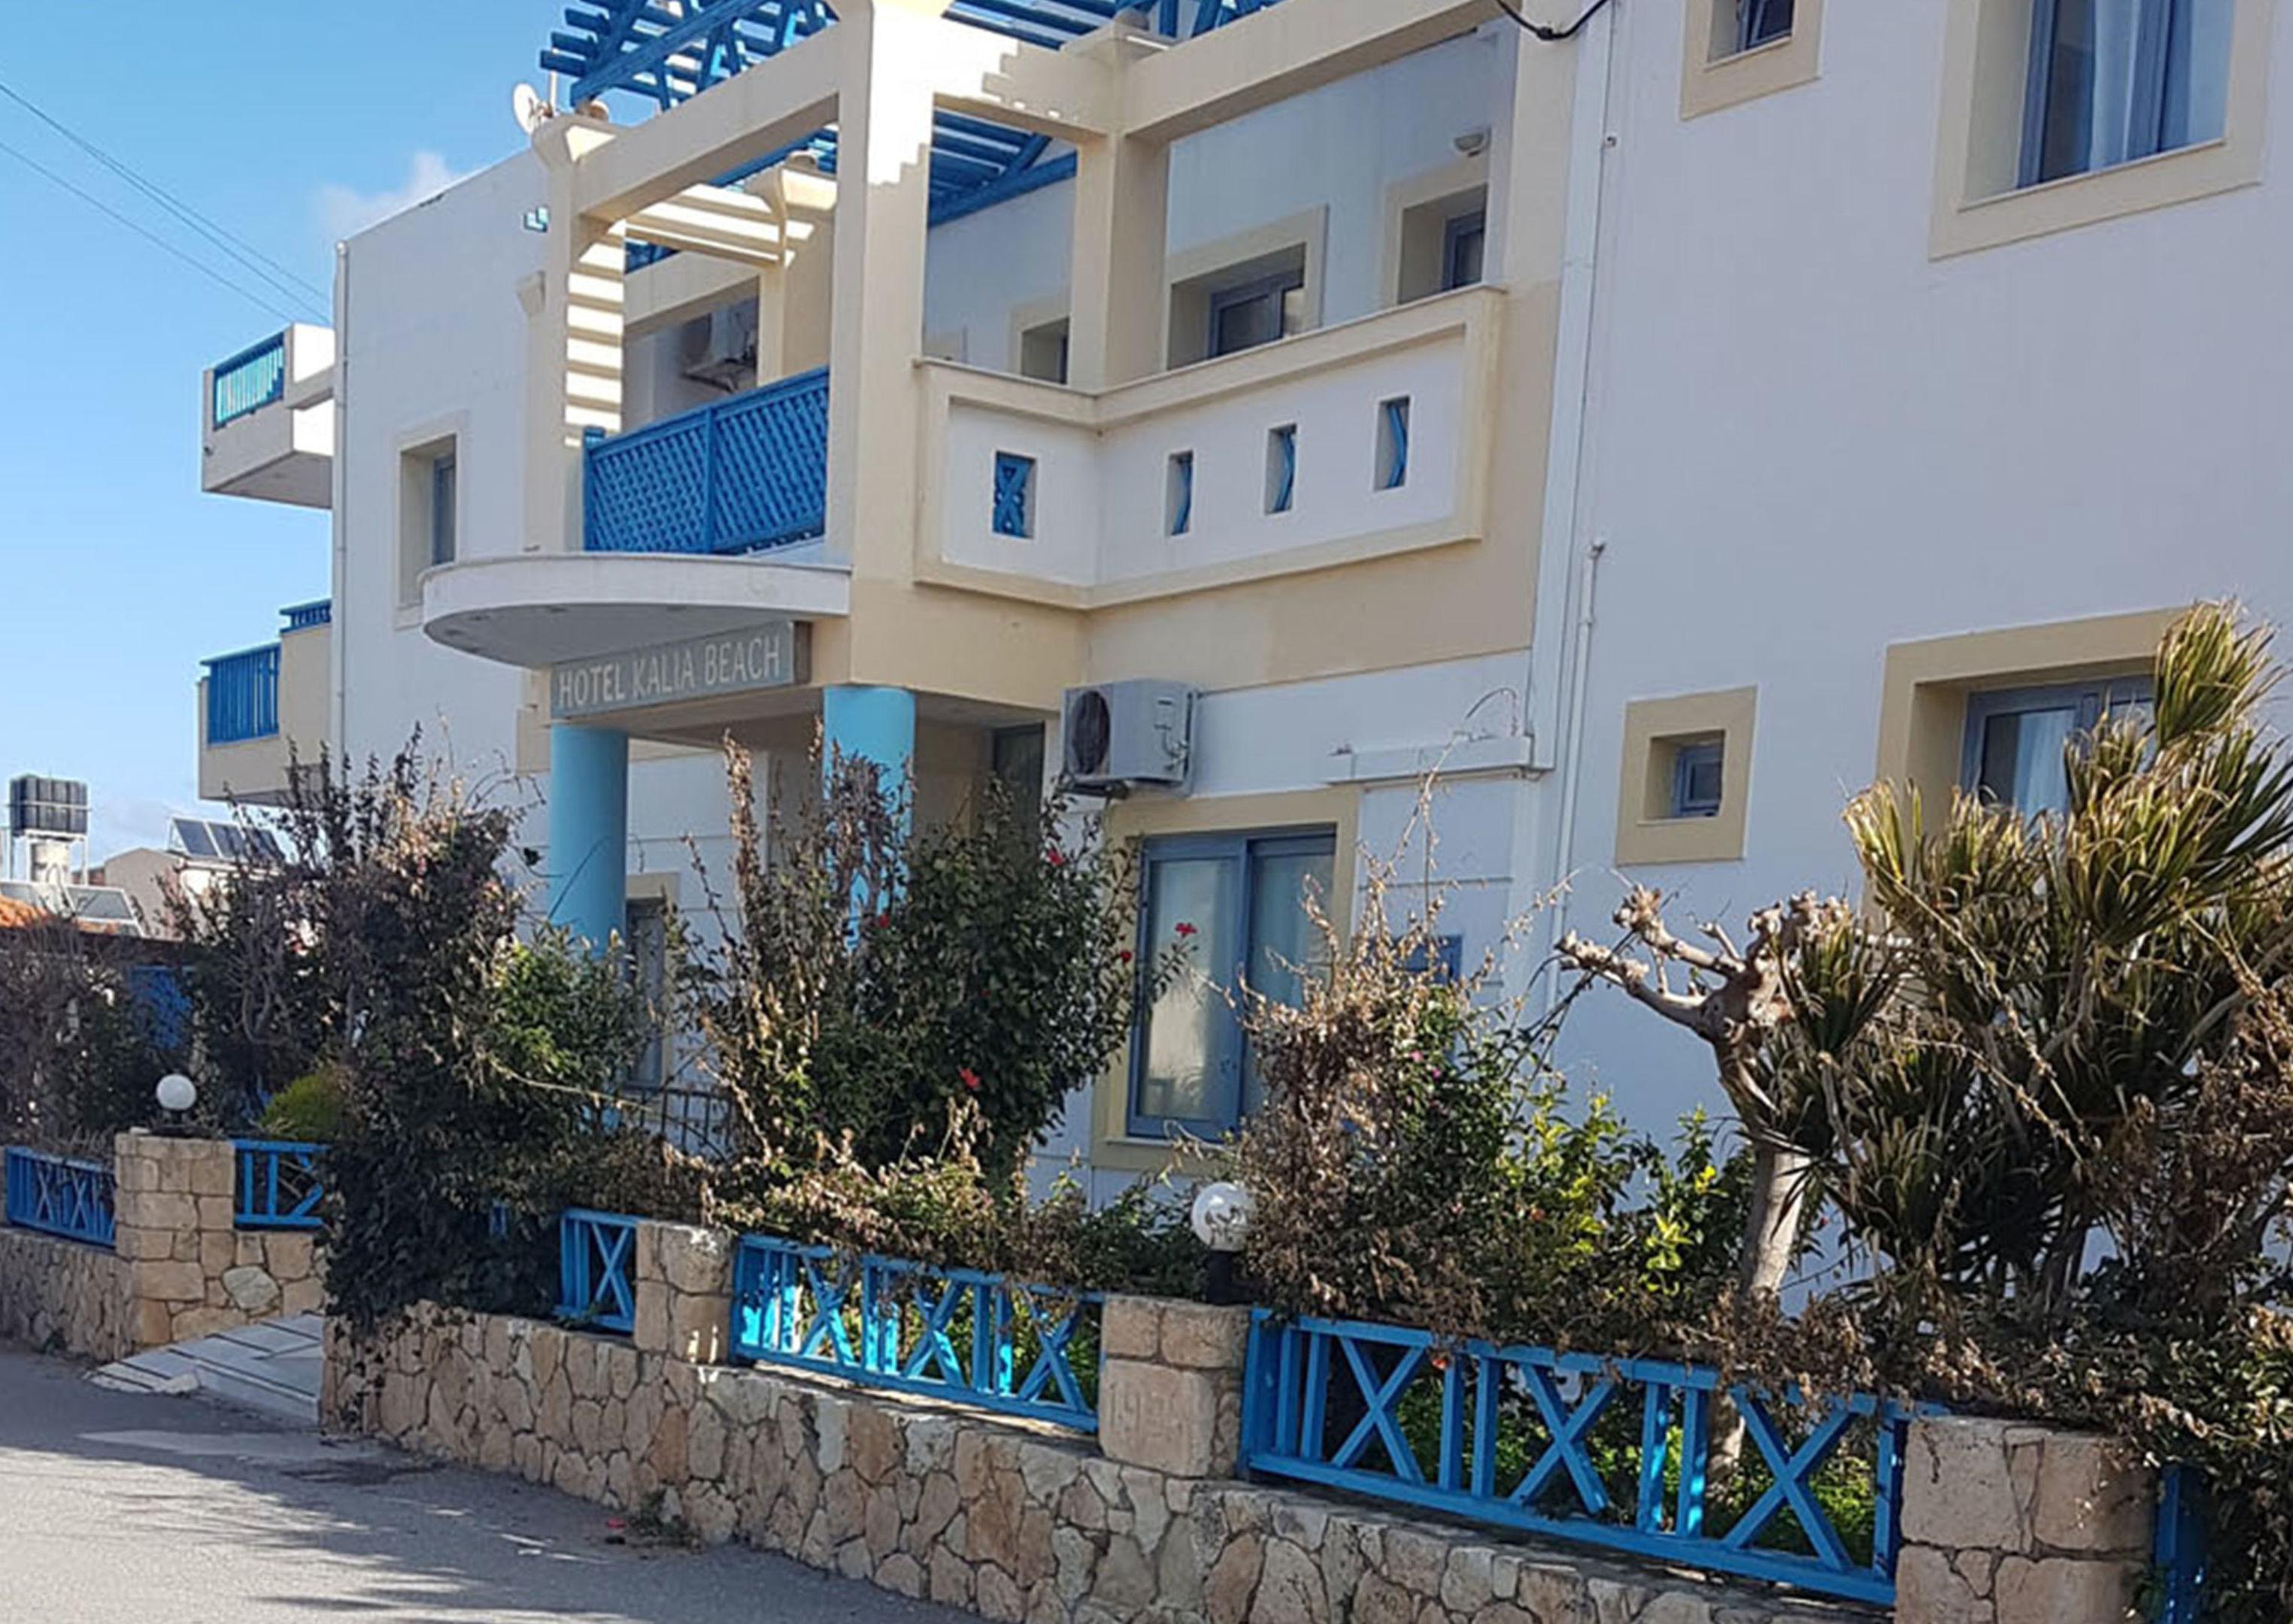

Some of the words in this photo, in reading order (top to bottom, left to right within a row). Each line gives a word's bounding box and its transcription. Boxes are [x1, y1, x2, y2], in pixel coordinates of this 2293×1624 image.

[558, 663, 625, 707] HOTEL
[633, 648, 696, 698] KALIA
[704, 637, 781, 686] BEACH
